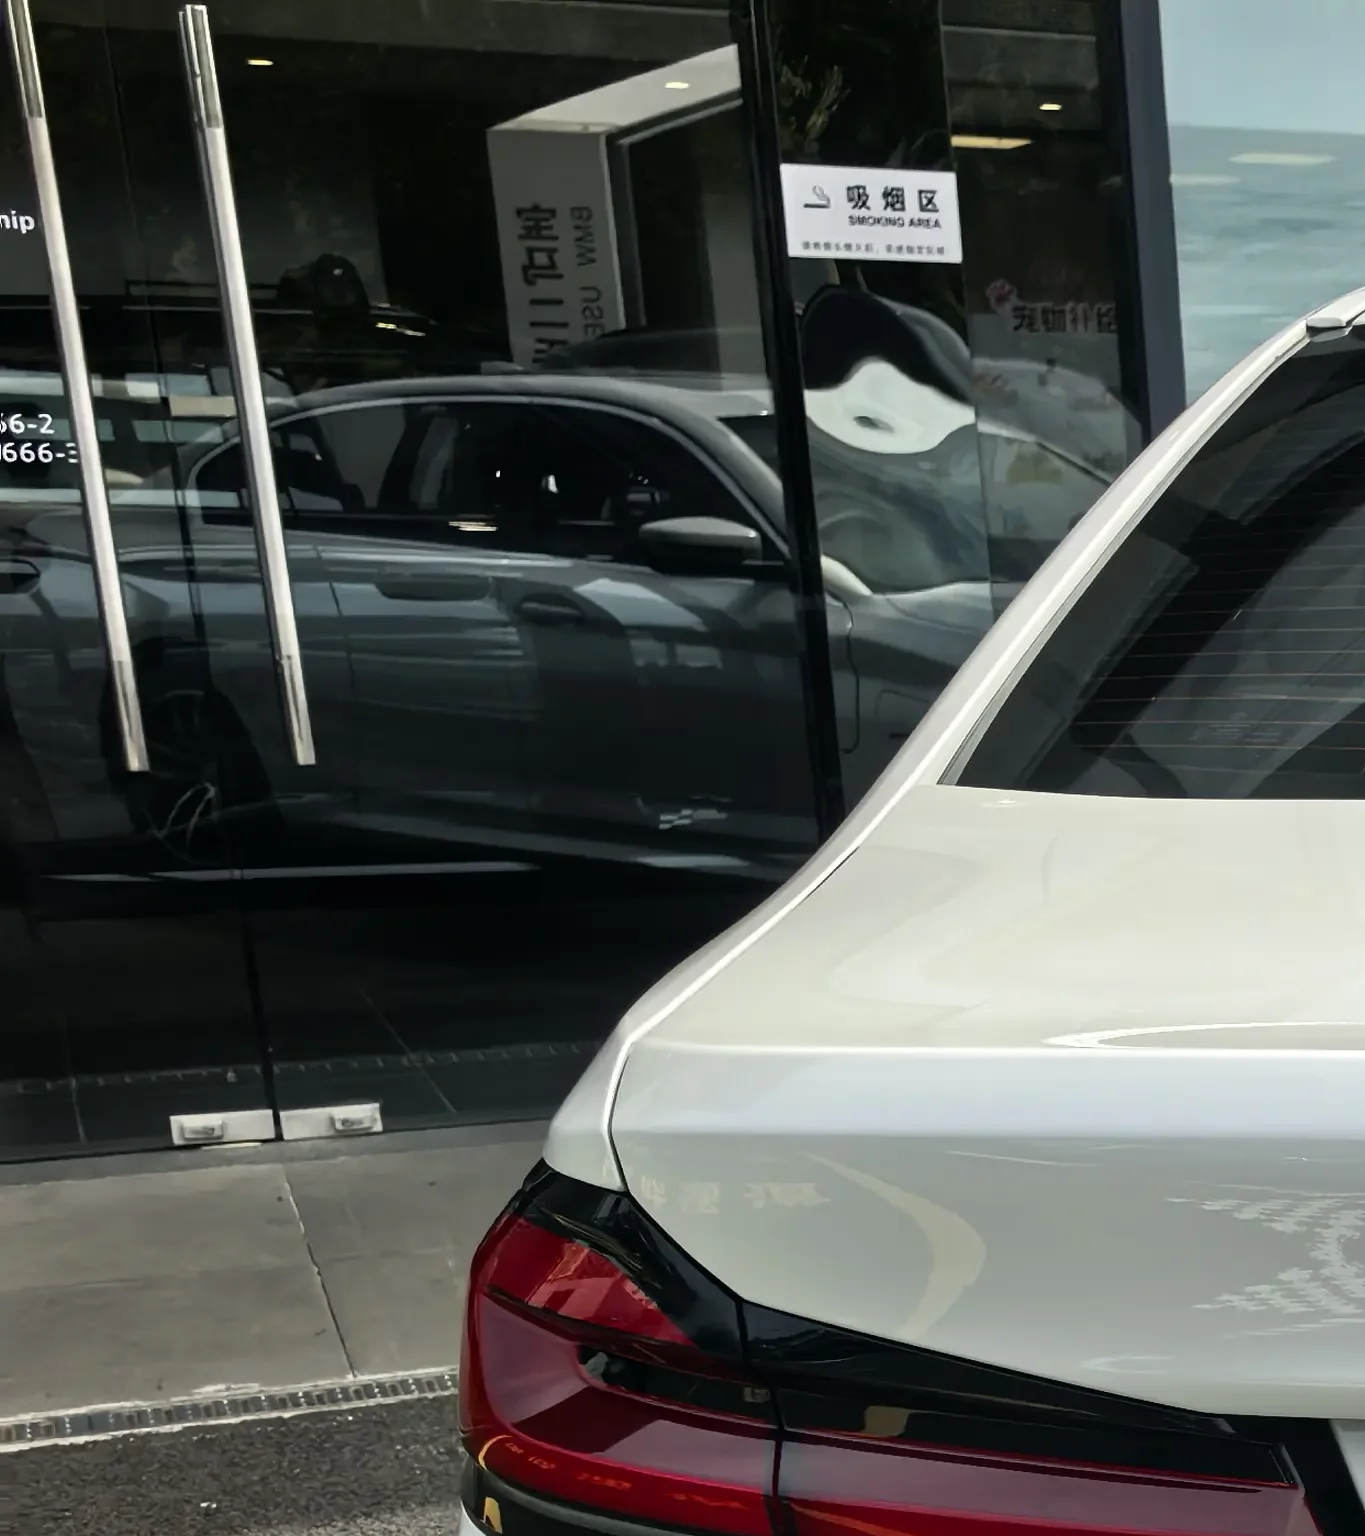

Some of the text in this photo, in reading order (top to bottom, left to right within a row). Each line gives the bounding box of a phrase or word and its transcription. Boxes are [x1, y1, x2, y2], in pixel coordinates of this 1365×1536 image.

[846, 185, 939, 213] 吸烟区
[848, 215, 941, 229] SMOKING AREA
